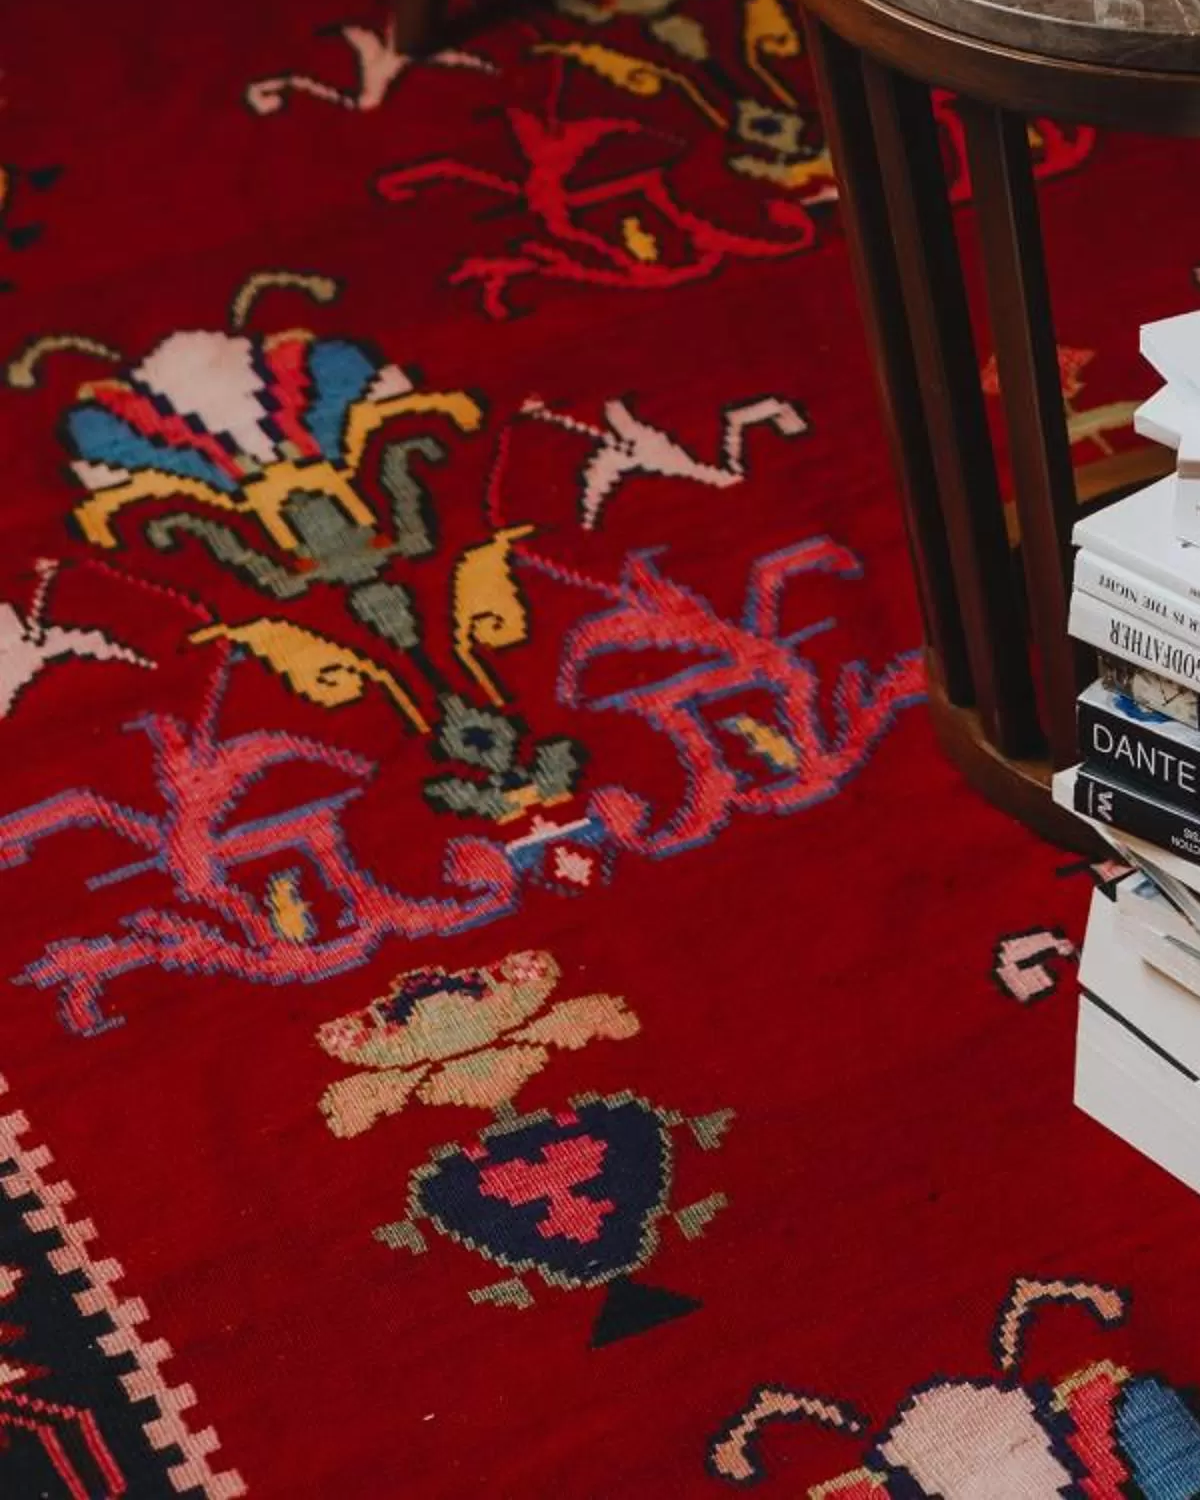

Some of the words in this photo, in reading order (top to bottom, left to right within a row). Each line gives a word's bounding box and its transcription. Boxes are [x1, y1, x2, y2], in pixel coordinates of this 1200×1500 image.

[1098, 573, 1139, 604] NIGHT
[1142, 594, 1169, 619] THE
[1092, 722, 1198, 794] DANTE
